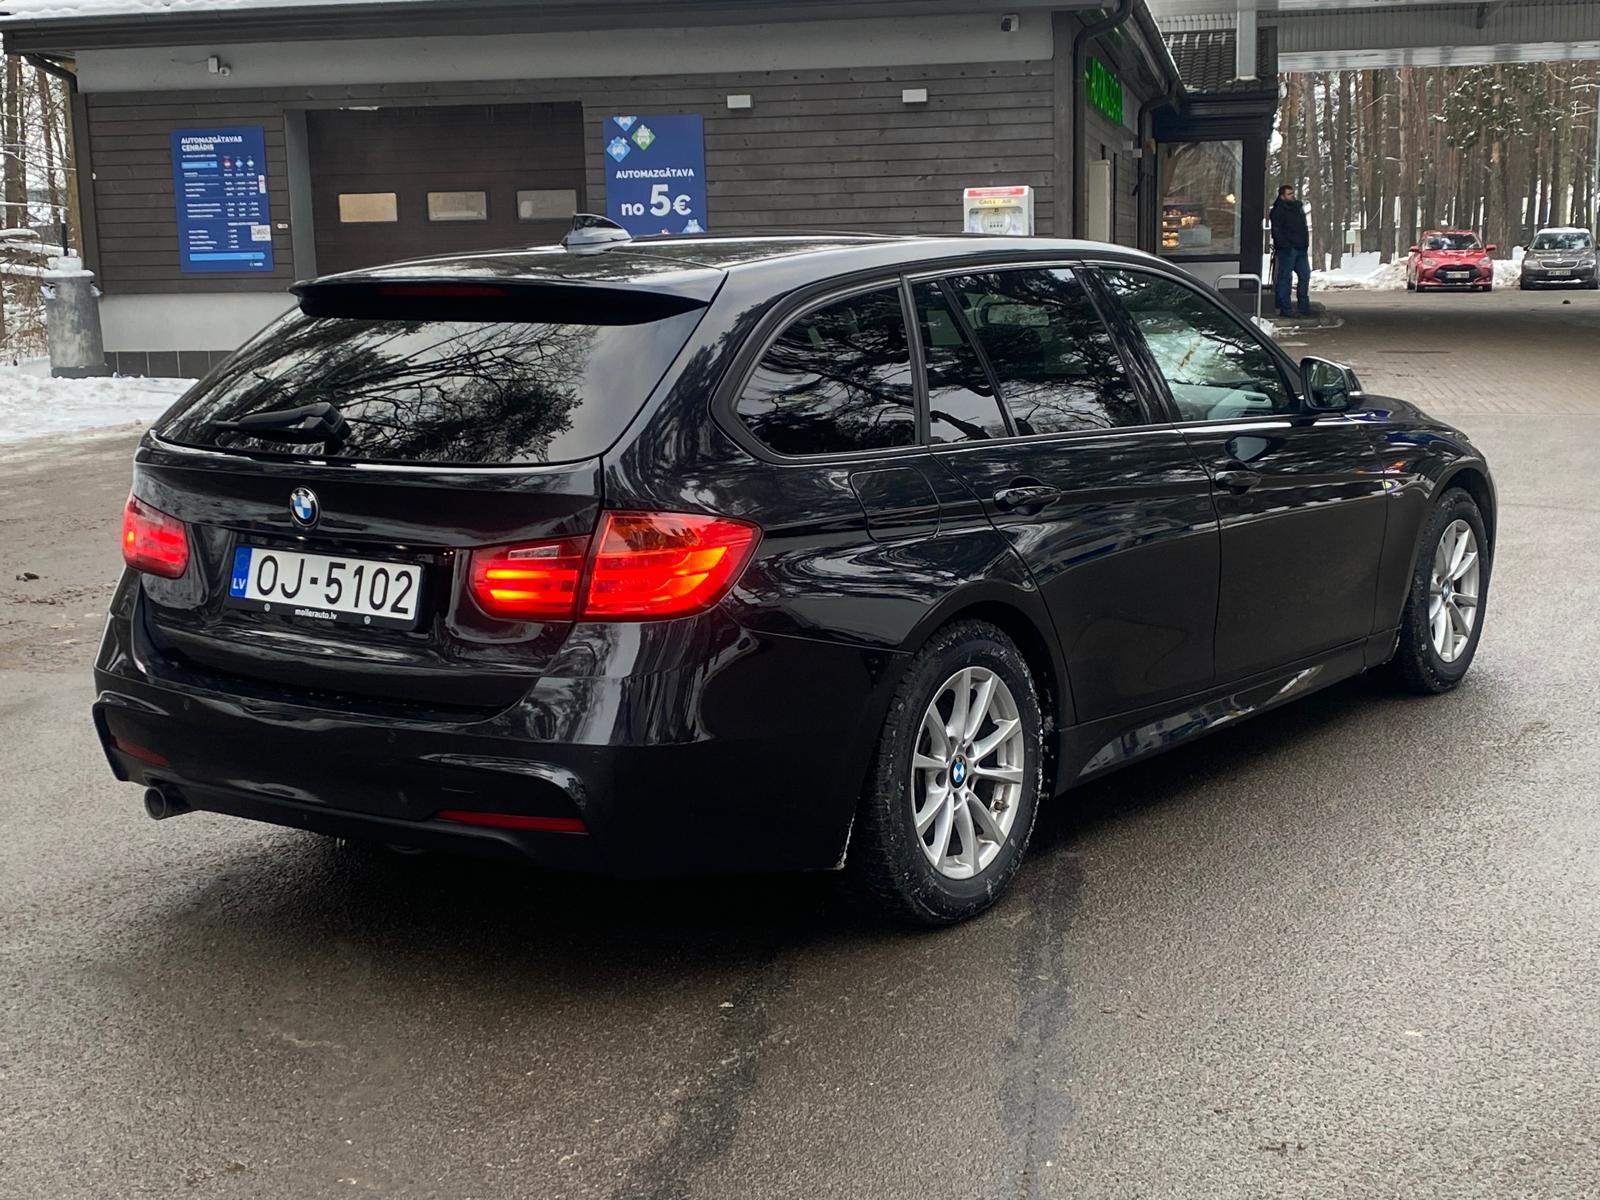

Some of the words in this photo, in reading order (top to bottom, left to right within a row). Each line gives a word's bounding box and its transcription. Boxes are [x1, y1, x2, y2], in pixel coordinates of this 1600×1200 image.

[181, 135, 242, 144] AUTOMAZGĀTAVAS
[615, 167, 694, 179] AUTOMAZGĀTAVA
[621, 202, 645, 216] no
[650, 184, 692, 216] 5€
[232, 577, 247, 590] LV
[256, 555, 413, 615] OJ-5102
[294, 608, 337, 620] mollerauto.lv
